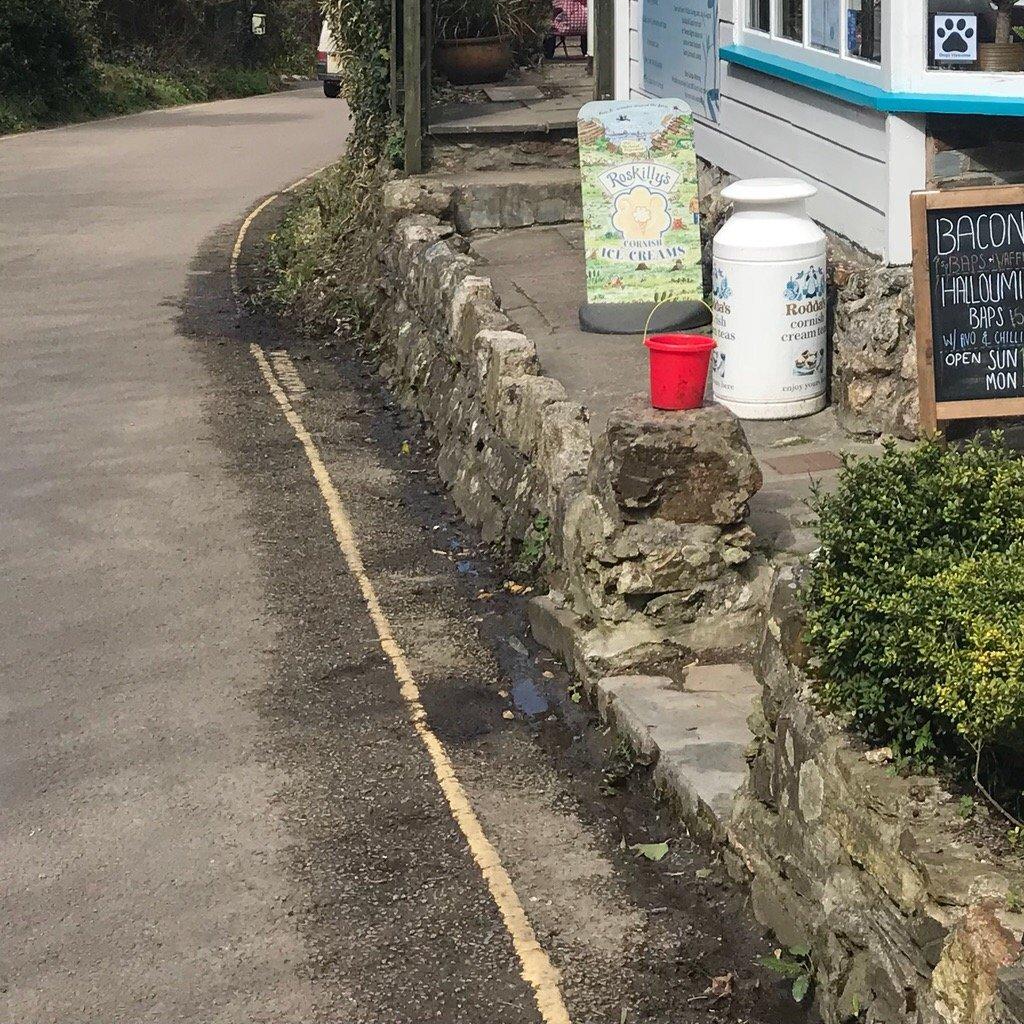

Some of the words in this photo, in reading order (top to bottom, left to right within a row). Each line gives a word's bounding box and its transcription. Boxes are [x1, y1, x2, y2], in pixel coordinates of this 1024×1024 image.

[607, 166, 671, 188] Roskilly's
[624, 239, 662, 248] CORNISH
[602, 248, 622, 260] ICE
[629, 247, 686, 261] CREAMS
[949, 253, 986, 274] BAPS
[941, 270, 1023, 307] HALLOUMI
[969, 305, 1004, 329] BAPS
[781, 330, 817, 342] cream
[960, 331, 976, 347] AVO
[982, 330, 991, 346] &
[994, 331, 1023, 344] CHILLI
[945, 351, 981, 366] OPEN
[988, 348, 1018, 370] SUN
[986, 372, 1017, 391] MON
